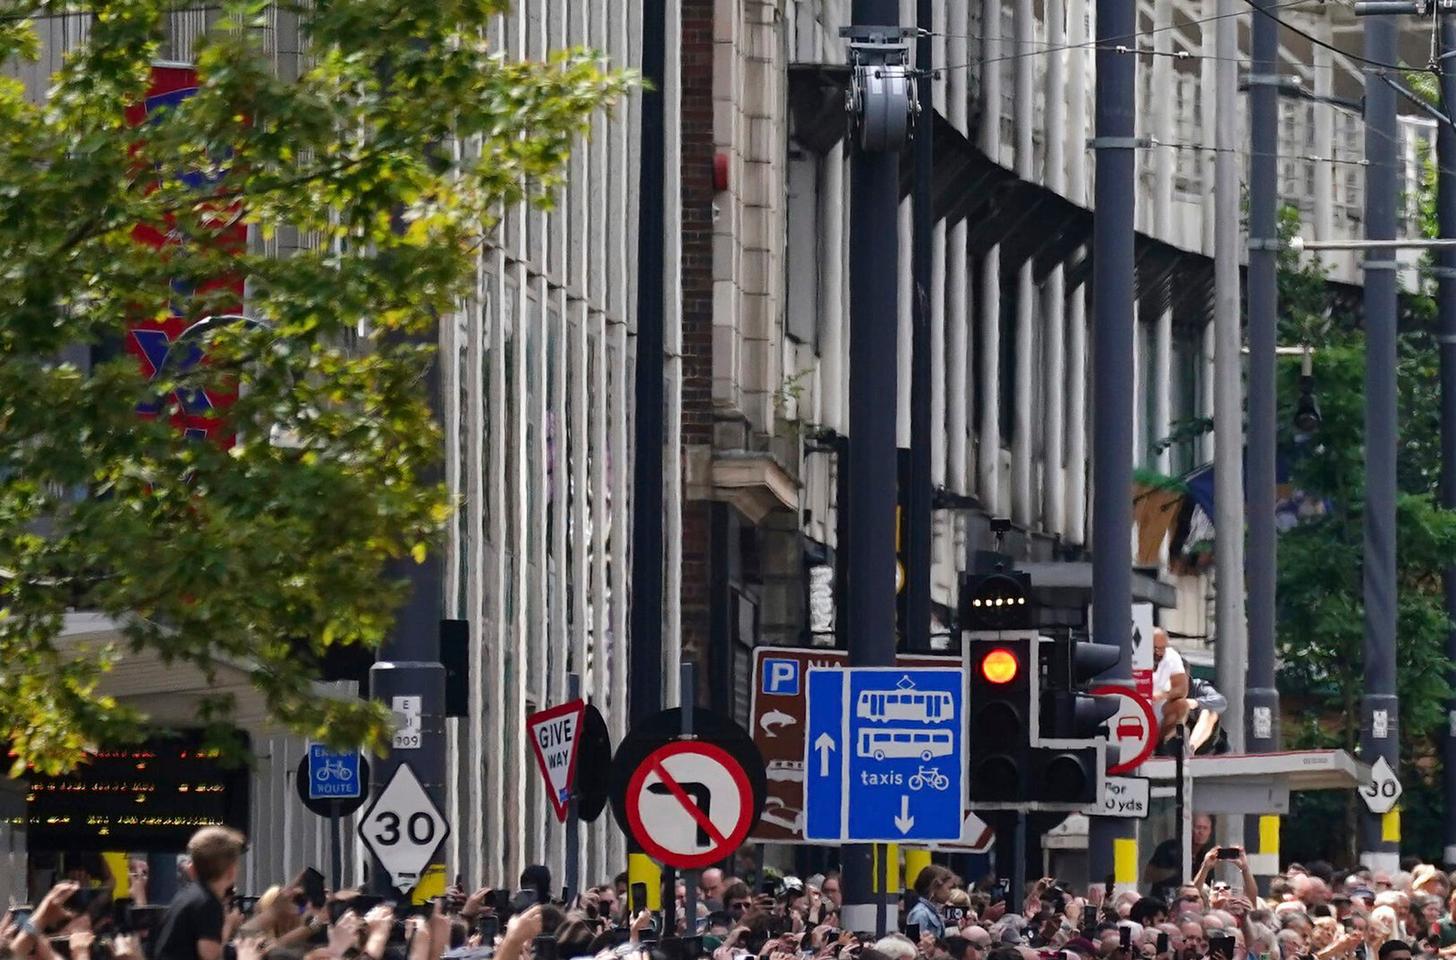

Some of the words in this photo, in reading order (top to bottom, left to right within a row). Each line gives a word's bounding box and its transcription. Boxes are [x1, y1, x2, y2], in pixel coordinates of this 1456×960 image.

[402, 700, 409, 710] E
[539, 719, 572, 750] GIVE
[548, 749, 569, 769] WAY
[861, 770, 903, 786] taxis
[317, 783, 353, 793] ROUTE
[1365, 779, 1396, 798] 30
[1118, 799, 1143, 812] yds
[375, 811, 435, 846] 30
